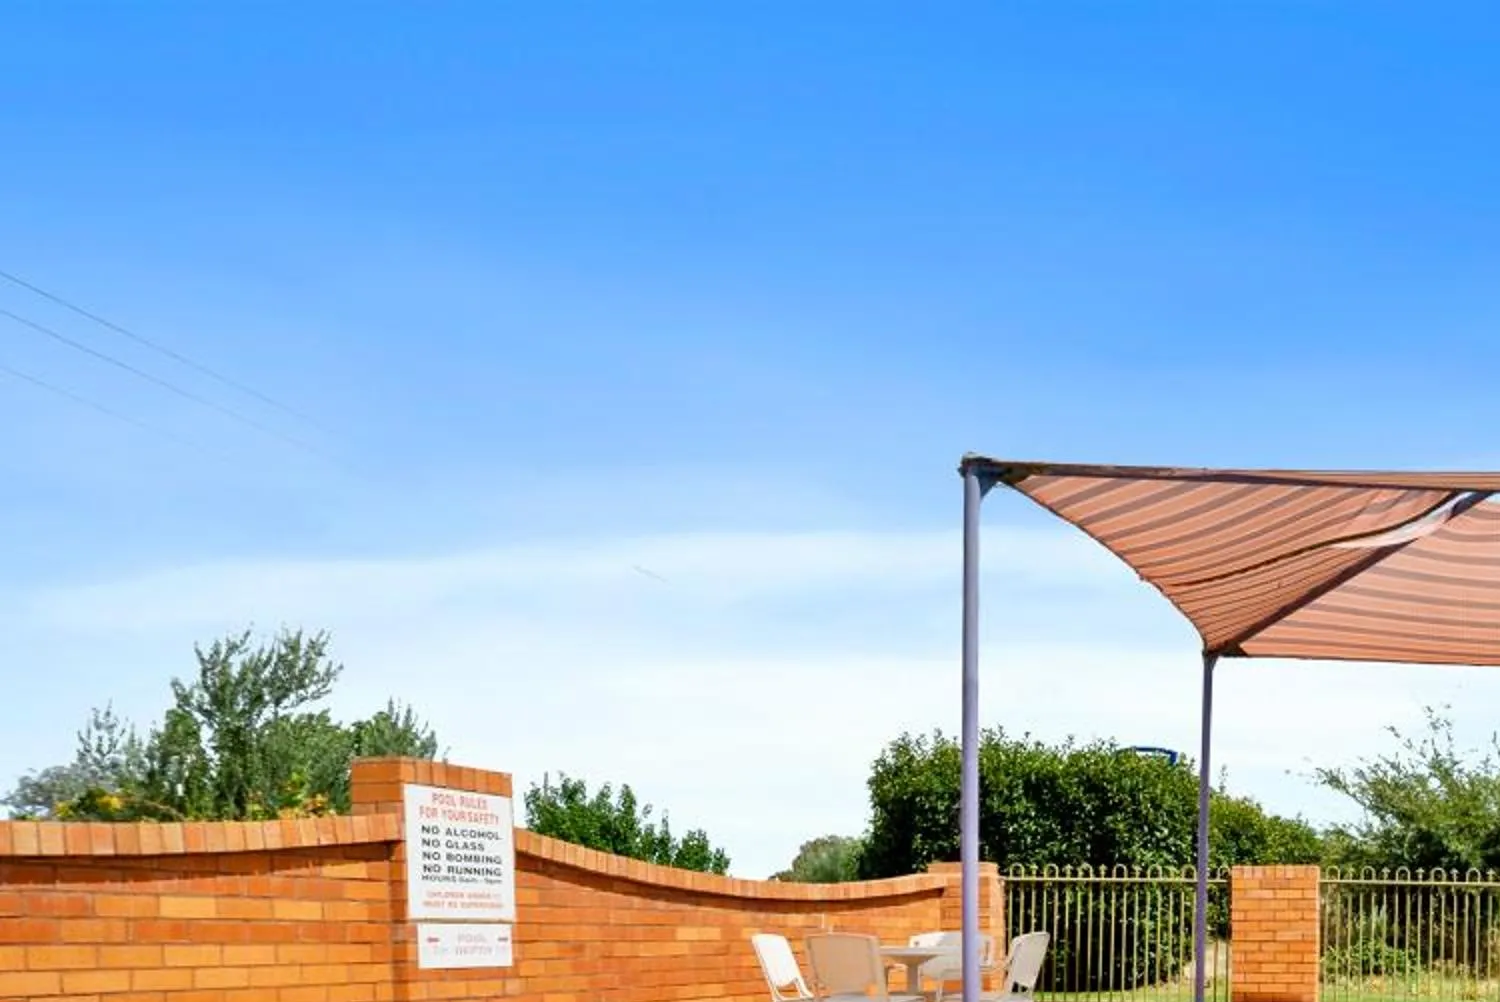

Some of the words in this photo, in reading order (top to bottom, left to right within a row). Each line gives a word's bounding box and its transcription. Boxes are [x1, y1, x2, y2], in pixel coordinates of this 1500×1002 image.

[431, 792, 458, 806] POOL
[459, 795, 488, 809] RULES
[418, 804, 438, 819] FOR
[441, 806, 467, 822] YOUR
[467, 809, 500, 824] SAFETY
[421, 825, 440, 835] NO
[445, 827, 503, 841] ALCOHOL
[421, 838, 441, 848] NO
[445, 840, 485, 852] GLASS
[422, 851, 441, 860] NO
[446, 852, 502, 865] BOMBING
[423, 864, 441, 873] NO
[447, 865, 502, 877] RUNNING
[421, 874, 457, 883] HOURS
